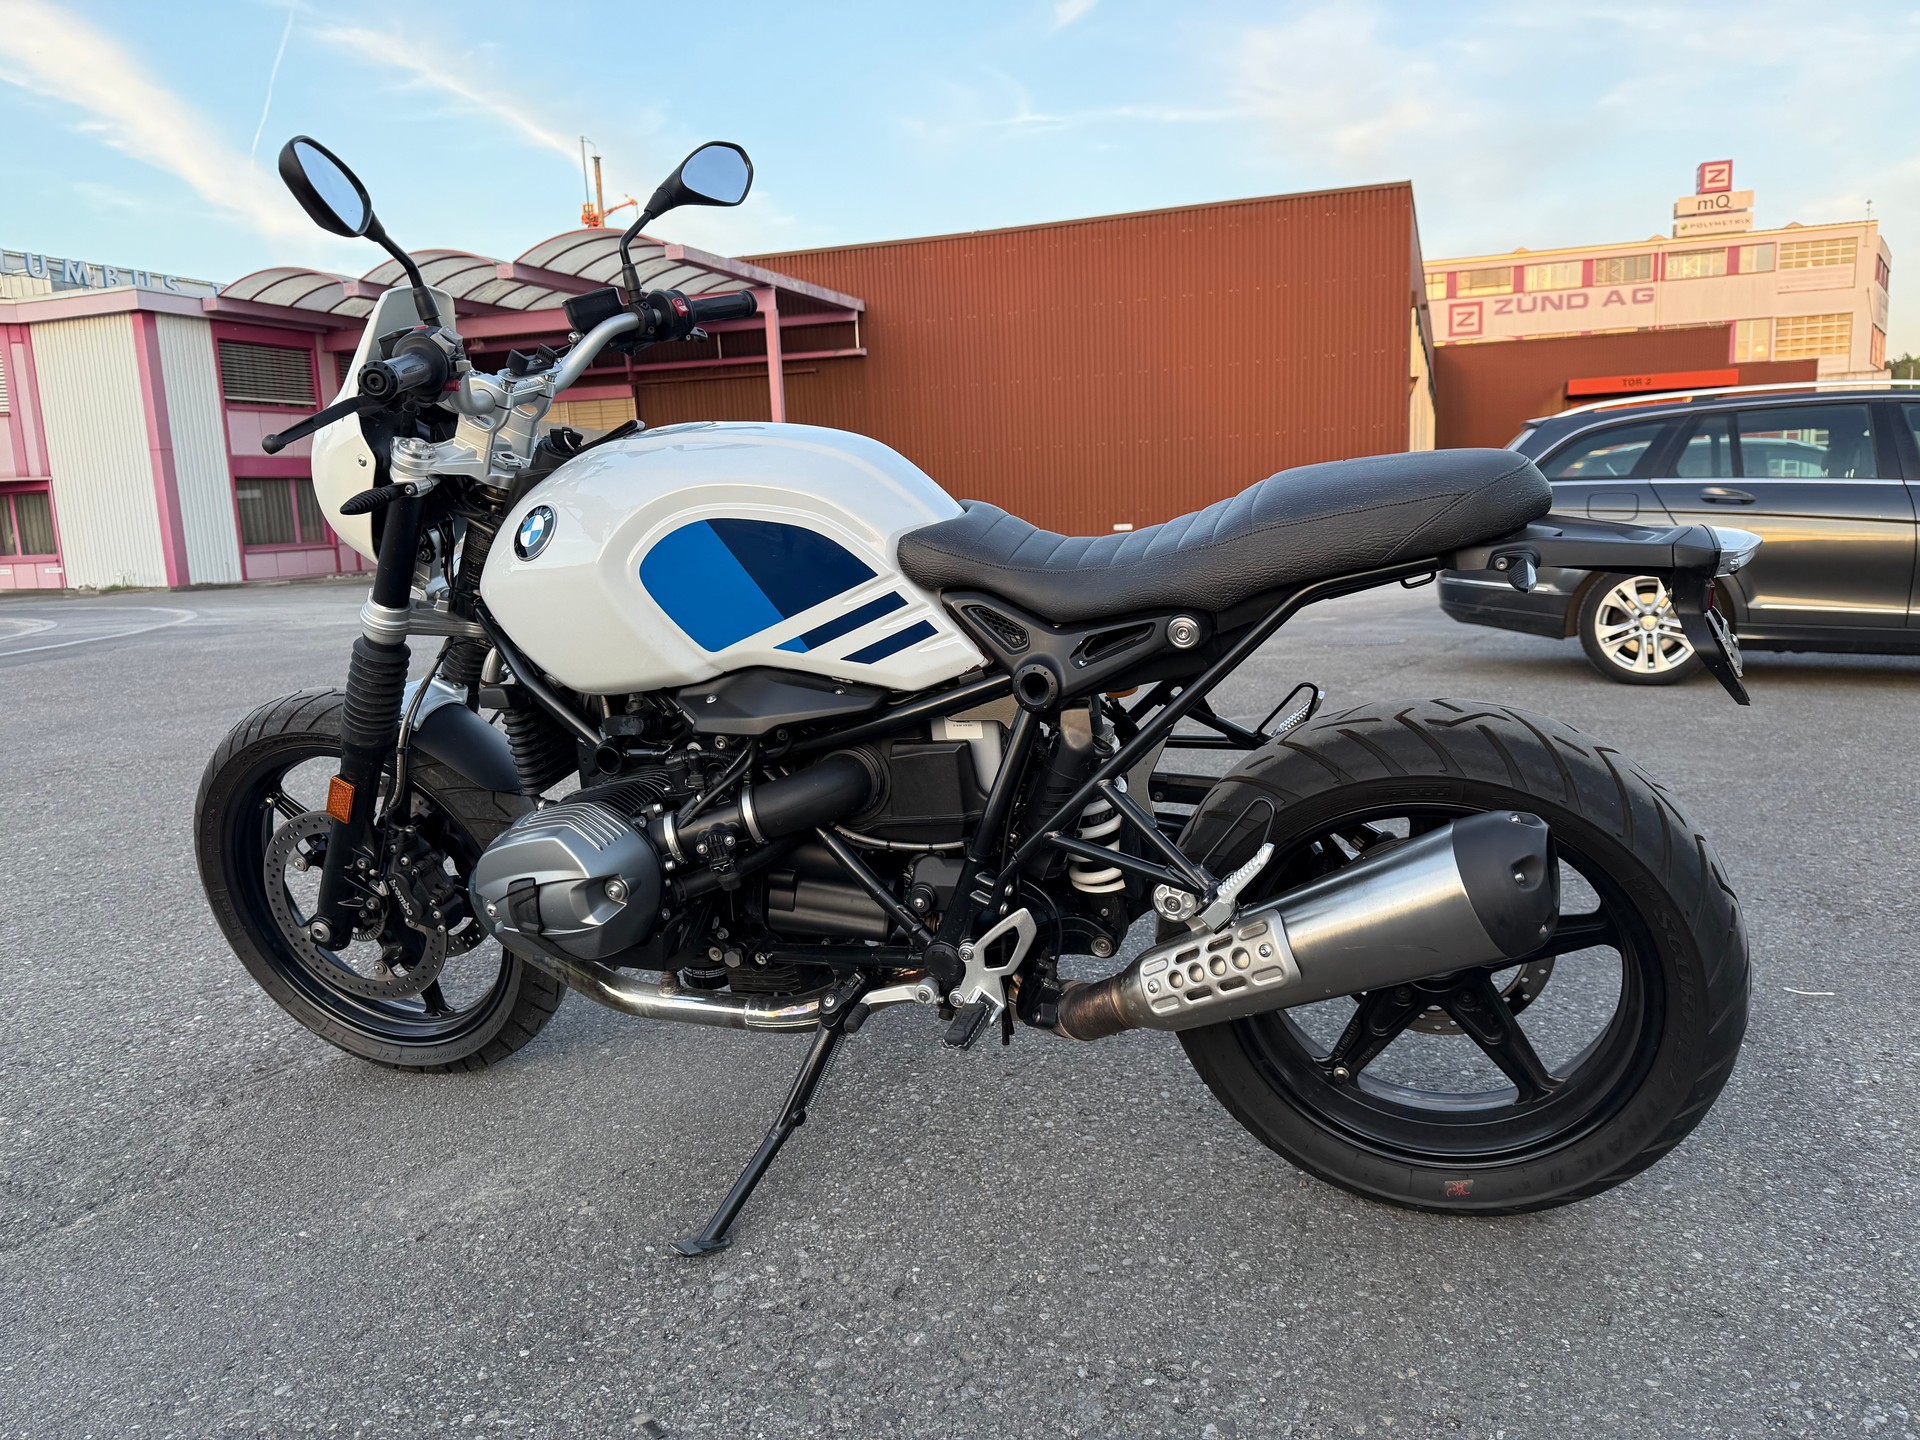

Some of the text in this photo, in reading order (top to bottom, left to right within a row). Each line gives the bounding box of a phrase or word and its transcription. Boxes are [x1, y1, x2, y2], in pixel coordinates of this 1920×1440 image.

[1707, 168, 1726, 184] Z
[1697, 194, 1733, 210] mQ
[1689, 218, 1751, 229] POLYMETRIX
[1456, 286, 1655, 328] Z ZÜND AG
[1622, 377, 1642, 387] TOR
[389, 879, 413, 915] brembo
